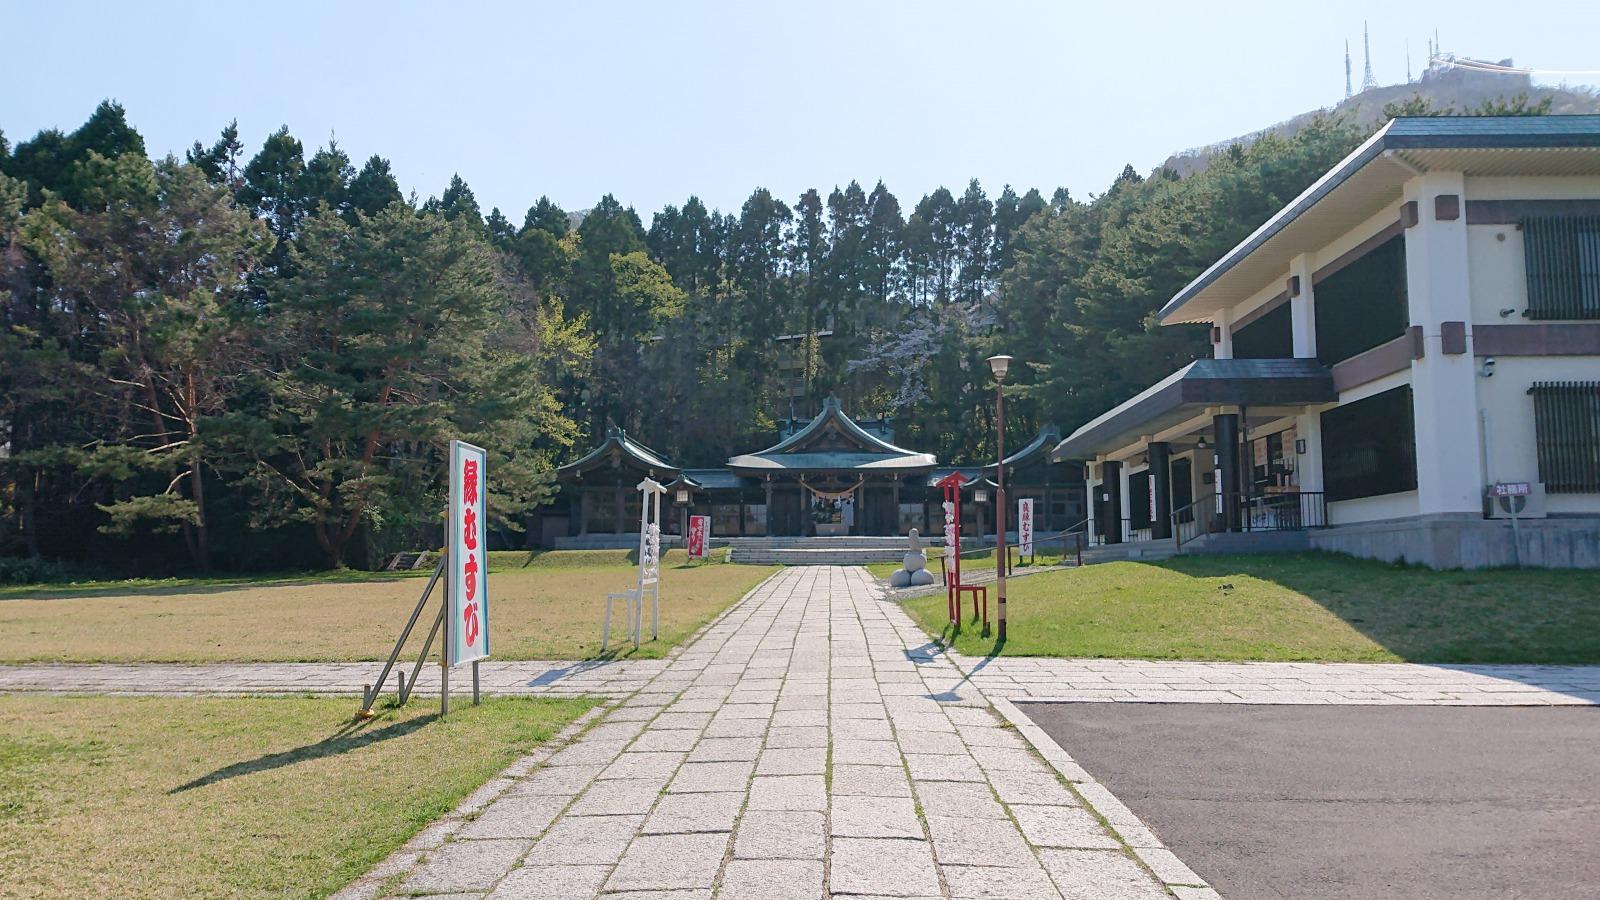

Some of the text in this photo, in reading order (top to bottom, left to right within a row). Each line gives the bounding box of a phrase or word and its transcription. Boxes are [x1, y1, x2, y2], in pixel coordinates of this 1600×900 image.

[1496, 484, 1528, 495] 社務所
[463, 458, 479, 647] 縁むすび
